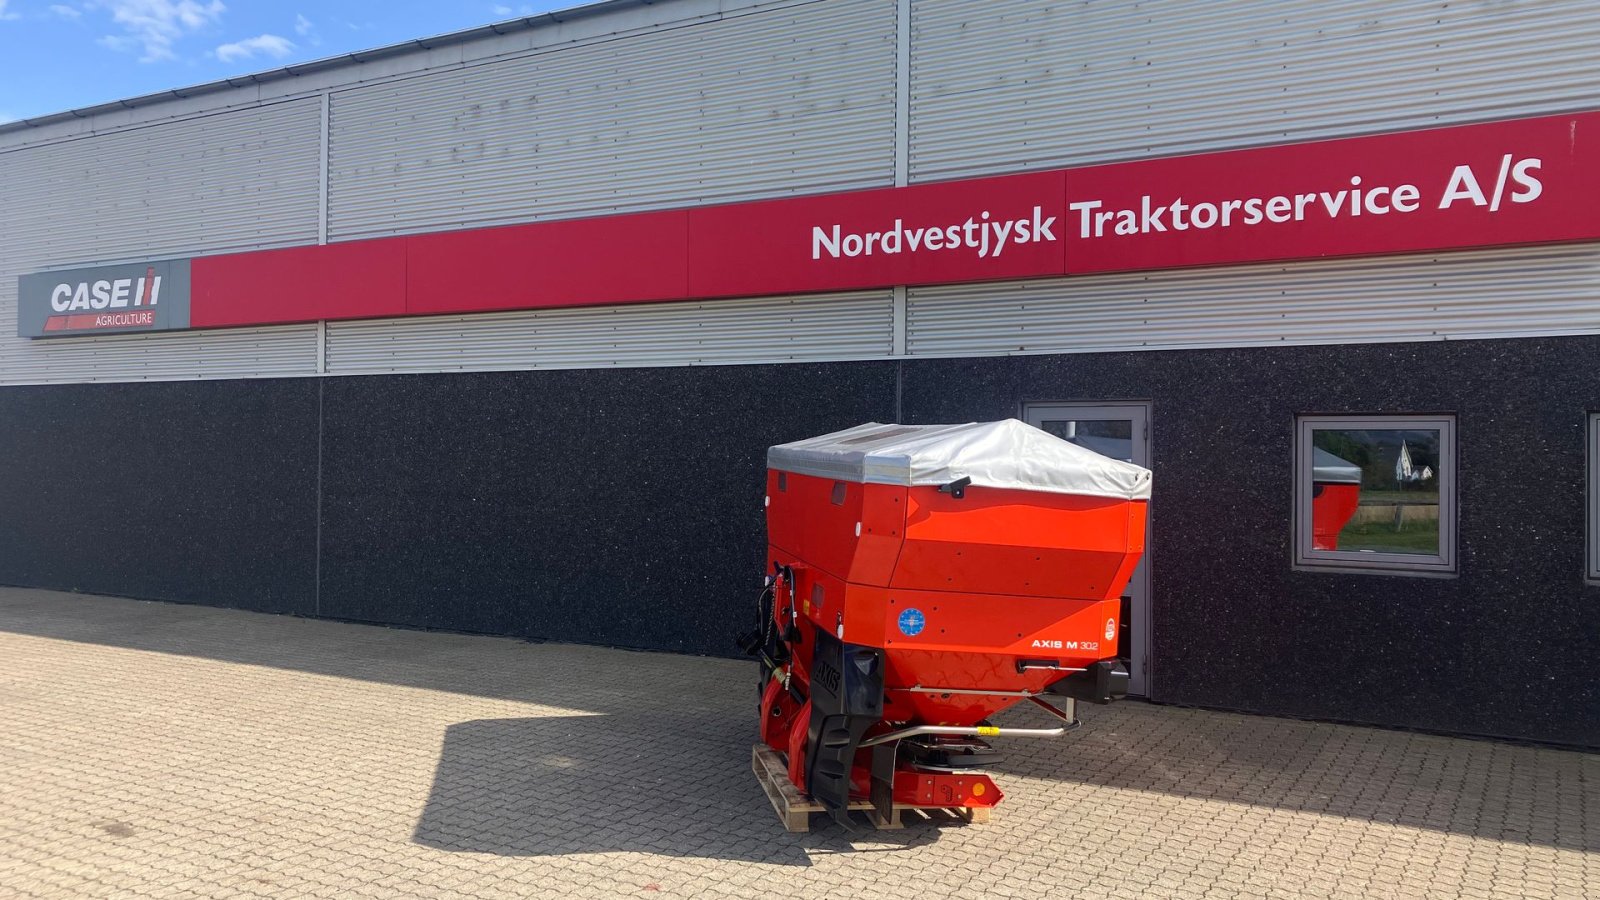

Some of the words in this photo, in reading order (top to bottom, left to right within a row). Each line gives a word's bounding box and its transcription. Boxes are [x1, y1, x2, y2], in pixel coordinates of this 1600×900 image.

[812, 205, 1057, 260] Nordvestjysk
[1069, 175, 1421, 239] Traktorservice
[1438, 153, 1543, 212] A/S
[51, 278, 132, 312] CASE
[95, 313, 152, 326] AGRICULTURE
[1031, 639, 1063, 649] AXIS
[1066, 640, 1078, 650] M
[814, 661, 841, 692] AXIS
